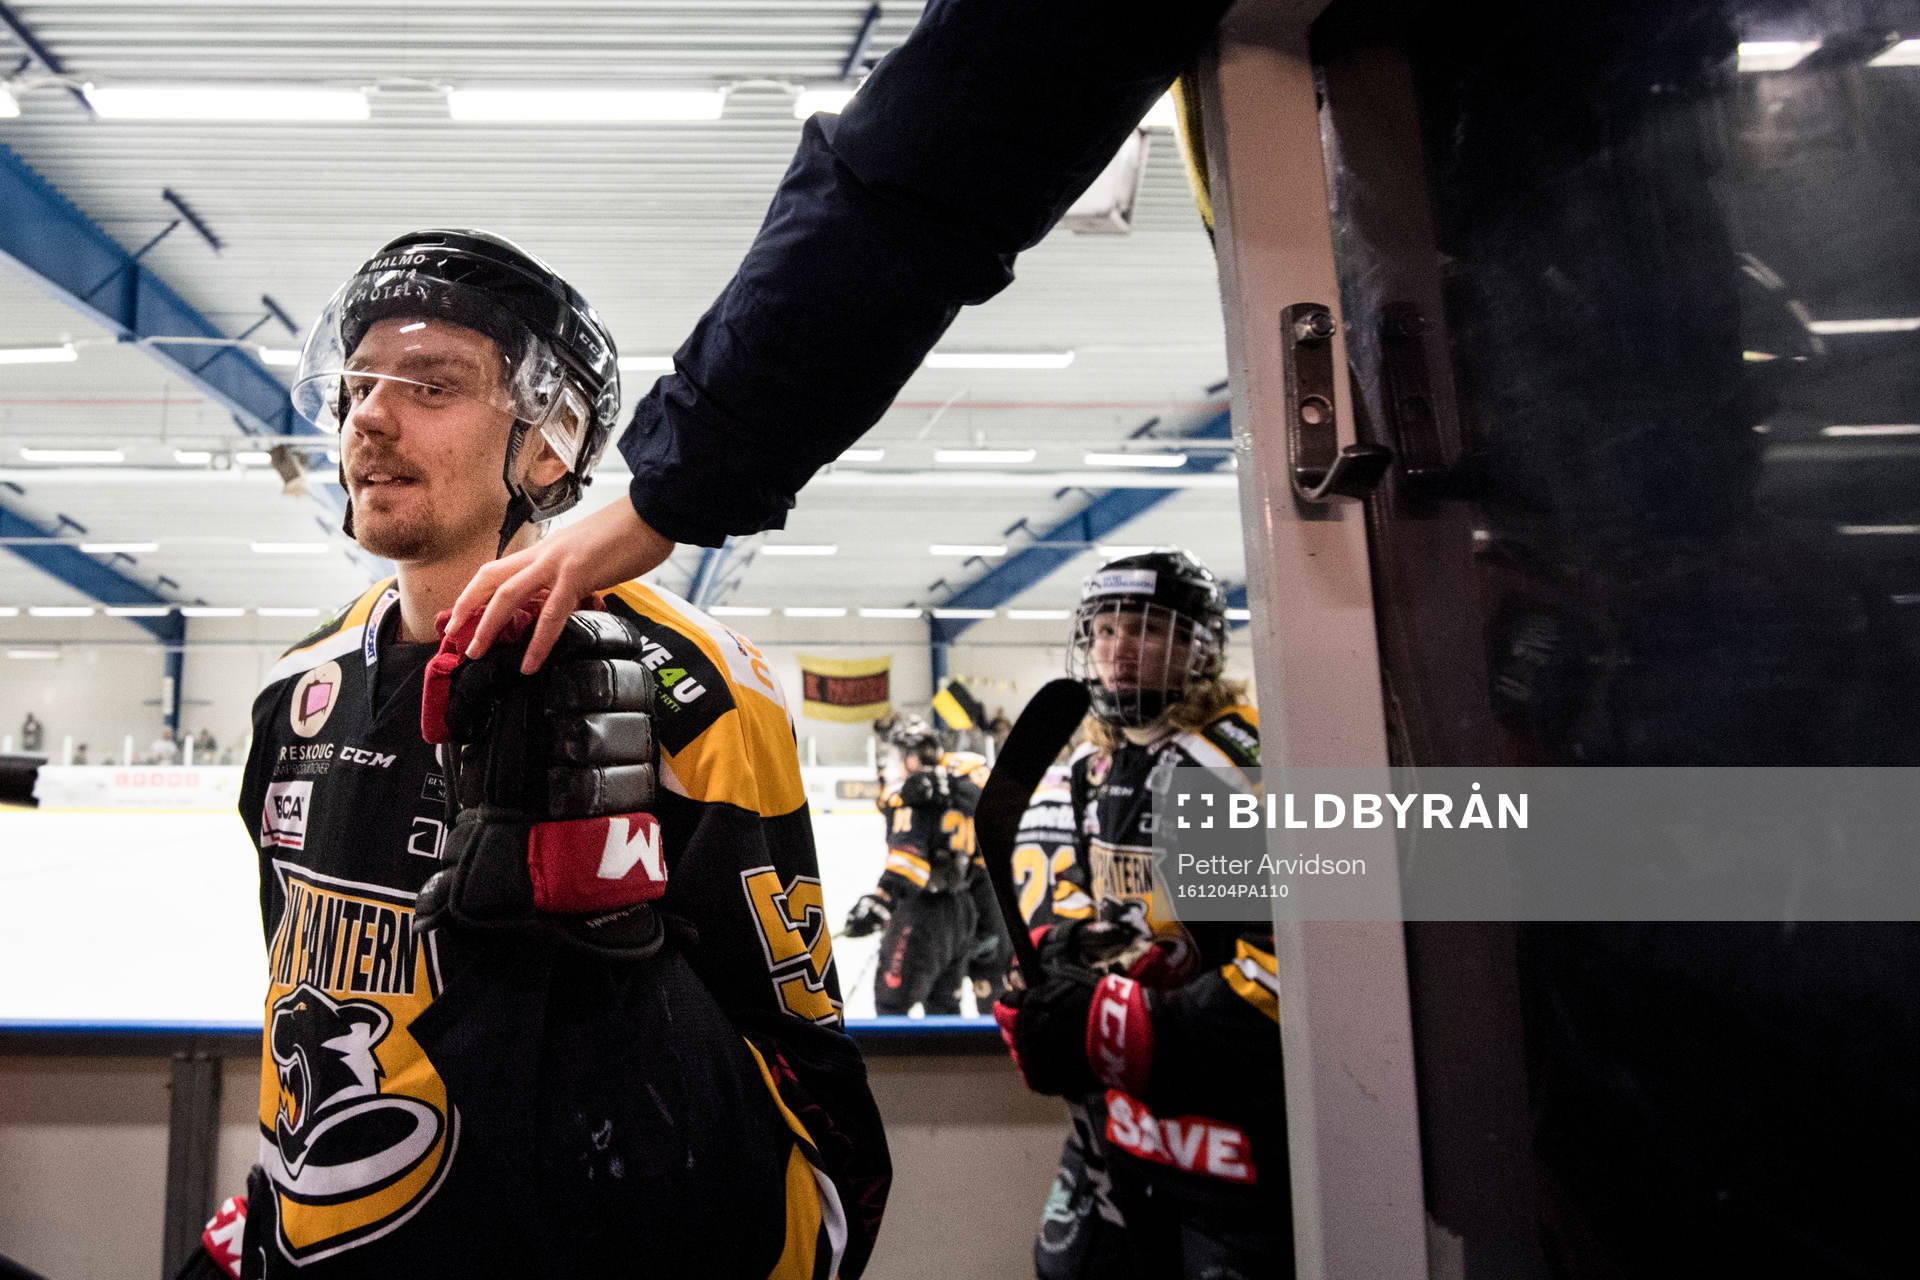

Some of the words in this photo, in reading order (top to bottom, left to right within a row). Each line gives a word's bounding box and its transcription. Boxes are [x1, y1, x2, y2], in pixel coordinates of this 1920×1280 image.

[356, 282, 411, 301] HOTEL
[279, 743, 334, 761] RESKOUG
[339, 746, 397, 769] CCM
[274, 795, 302, 821] BCA
[297, 890, 420, 995] PANTERN
[1109, 1096, 1249, 1181] SAVE
